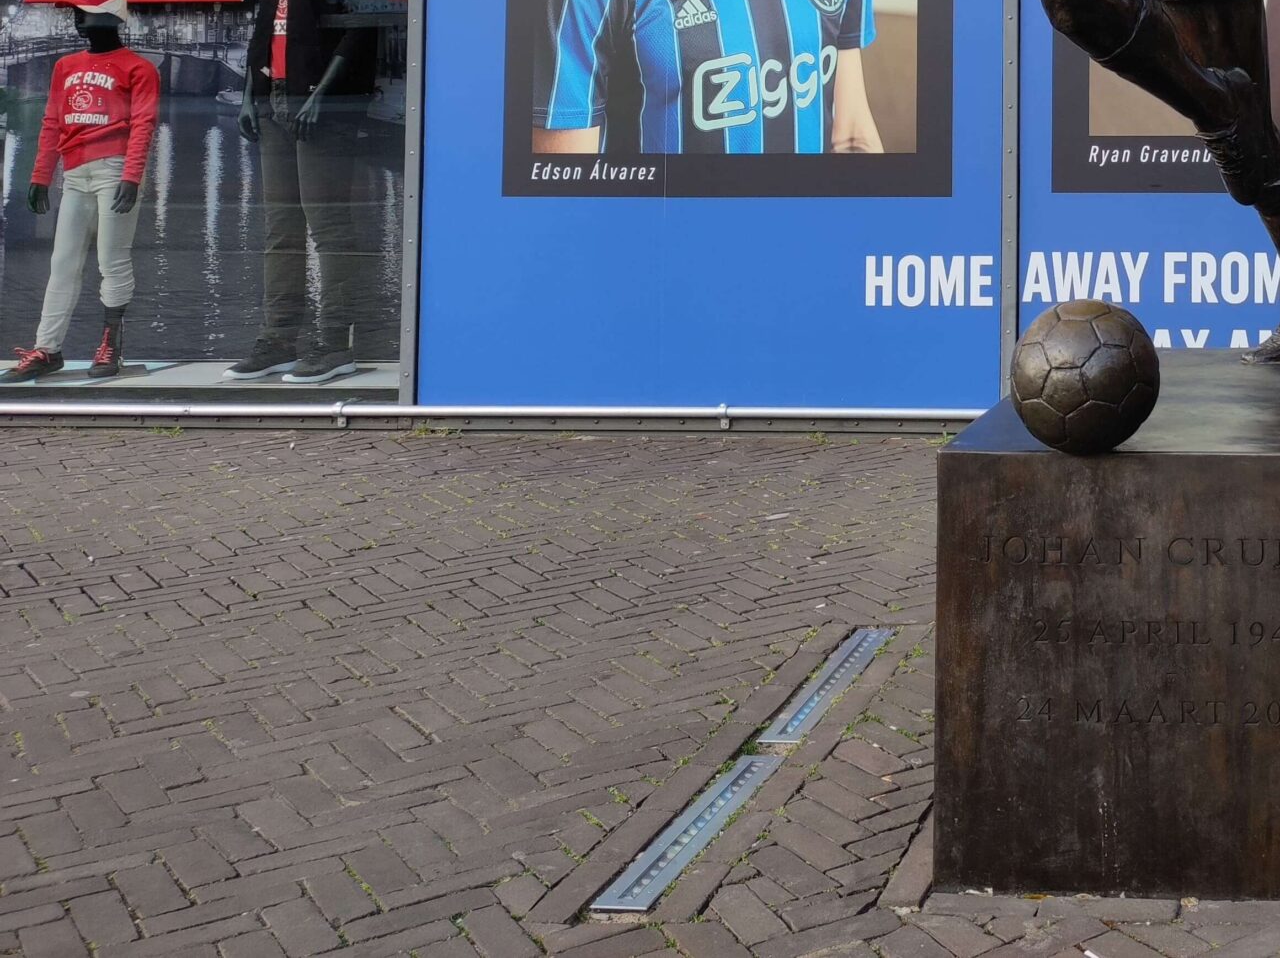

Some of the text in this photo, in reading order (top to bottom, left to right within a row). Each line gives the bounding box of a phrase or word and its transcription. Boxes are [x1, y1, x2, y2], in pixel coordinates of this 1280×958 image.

[674, 10, 717, 30] adidas
[83, 71, 115, 90] AJAX
[1088, 145, 1211, 166] Ryan Gravenb
[531, 159, 657, 180] Edson Álvarez
[865, 255, 994, 307] HOME
[1022, 251, 1149, 303] AWAY
[980, 535, 1147, 566] JOHAN
[1034, 619, 1072, 644] 25
[1087, 619, 1212, 646] APRIL
[1016, 696, 1053, 723] 24
[1075, 698, 1229, 726] MAART
